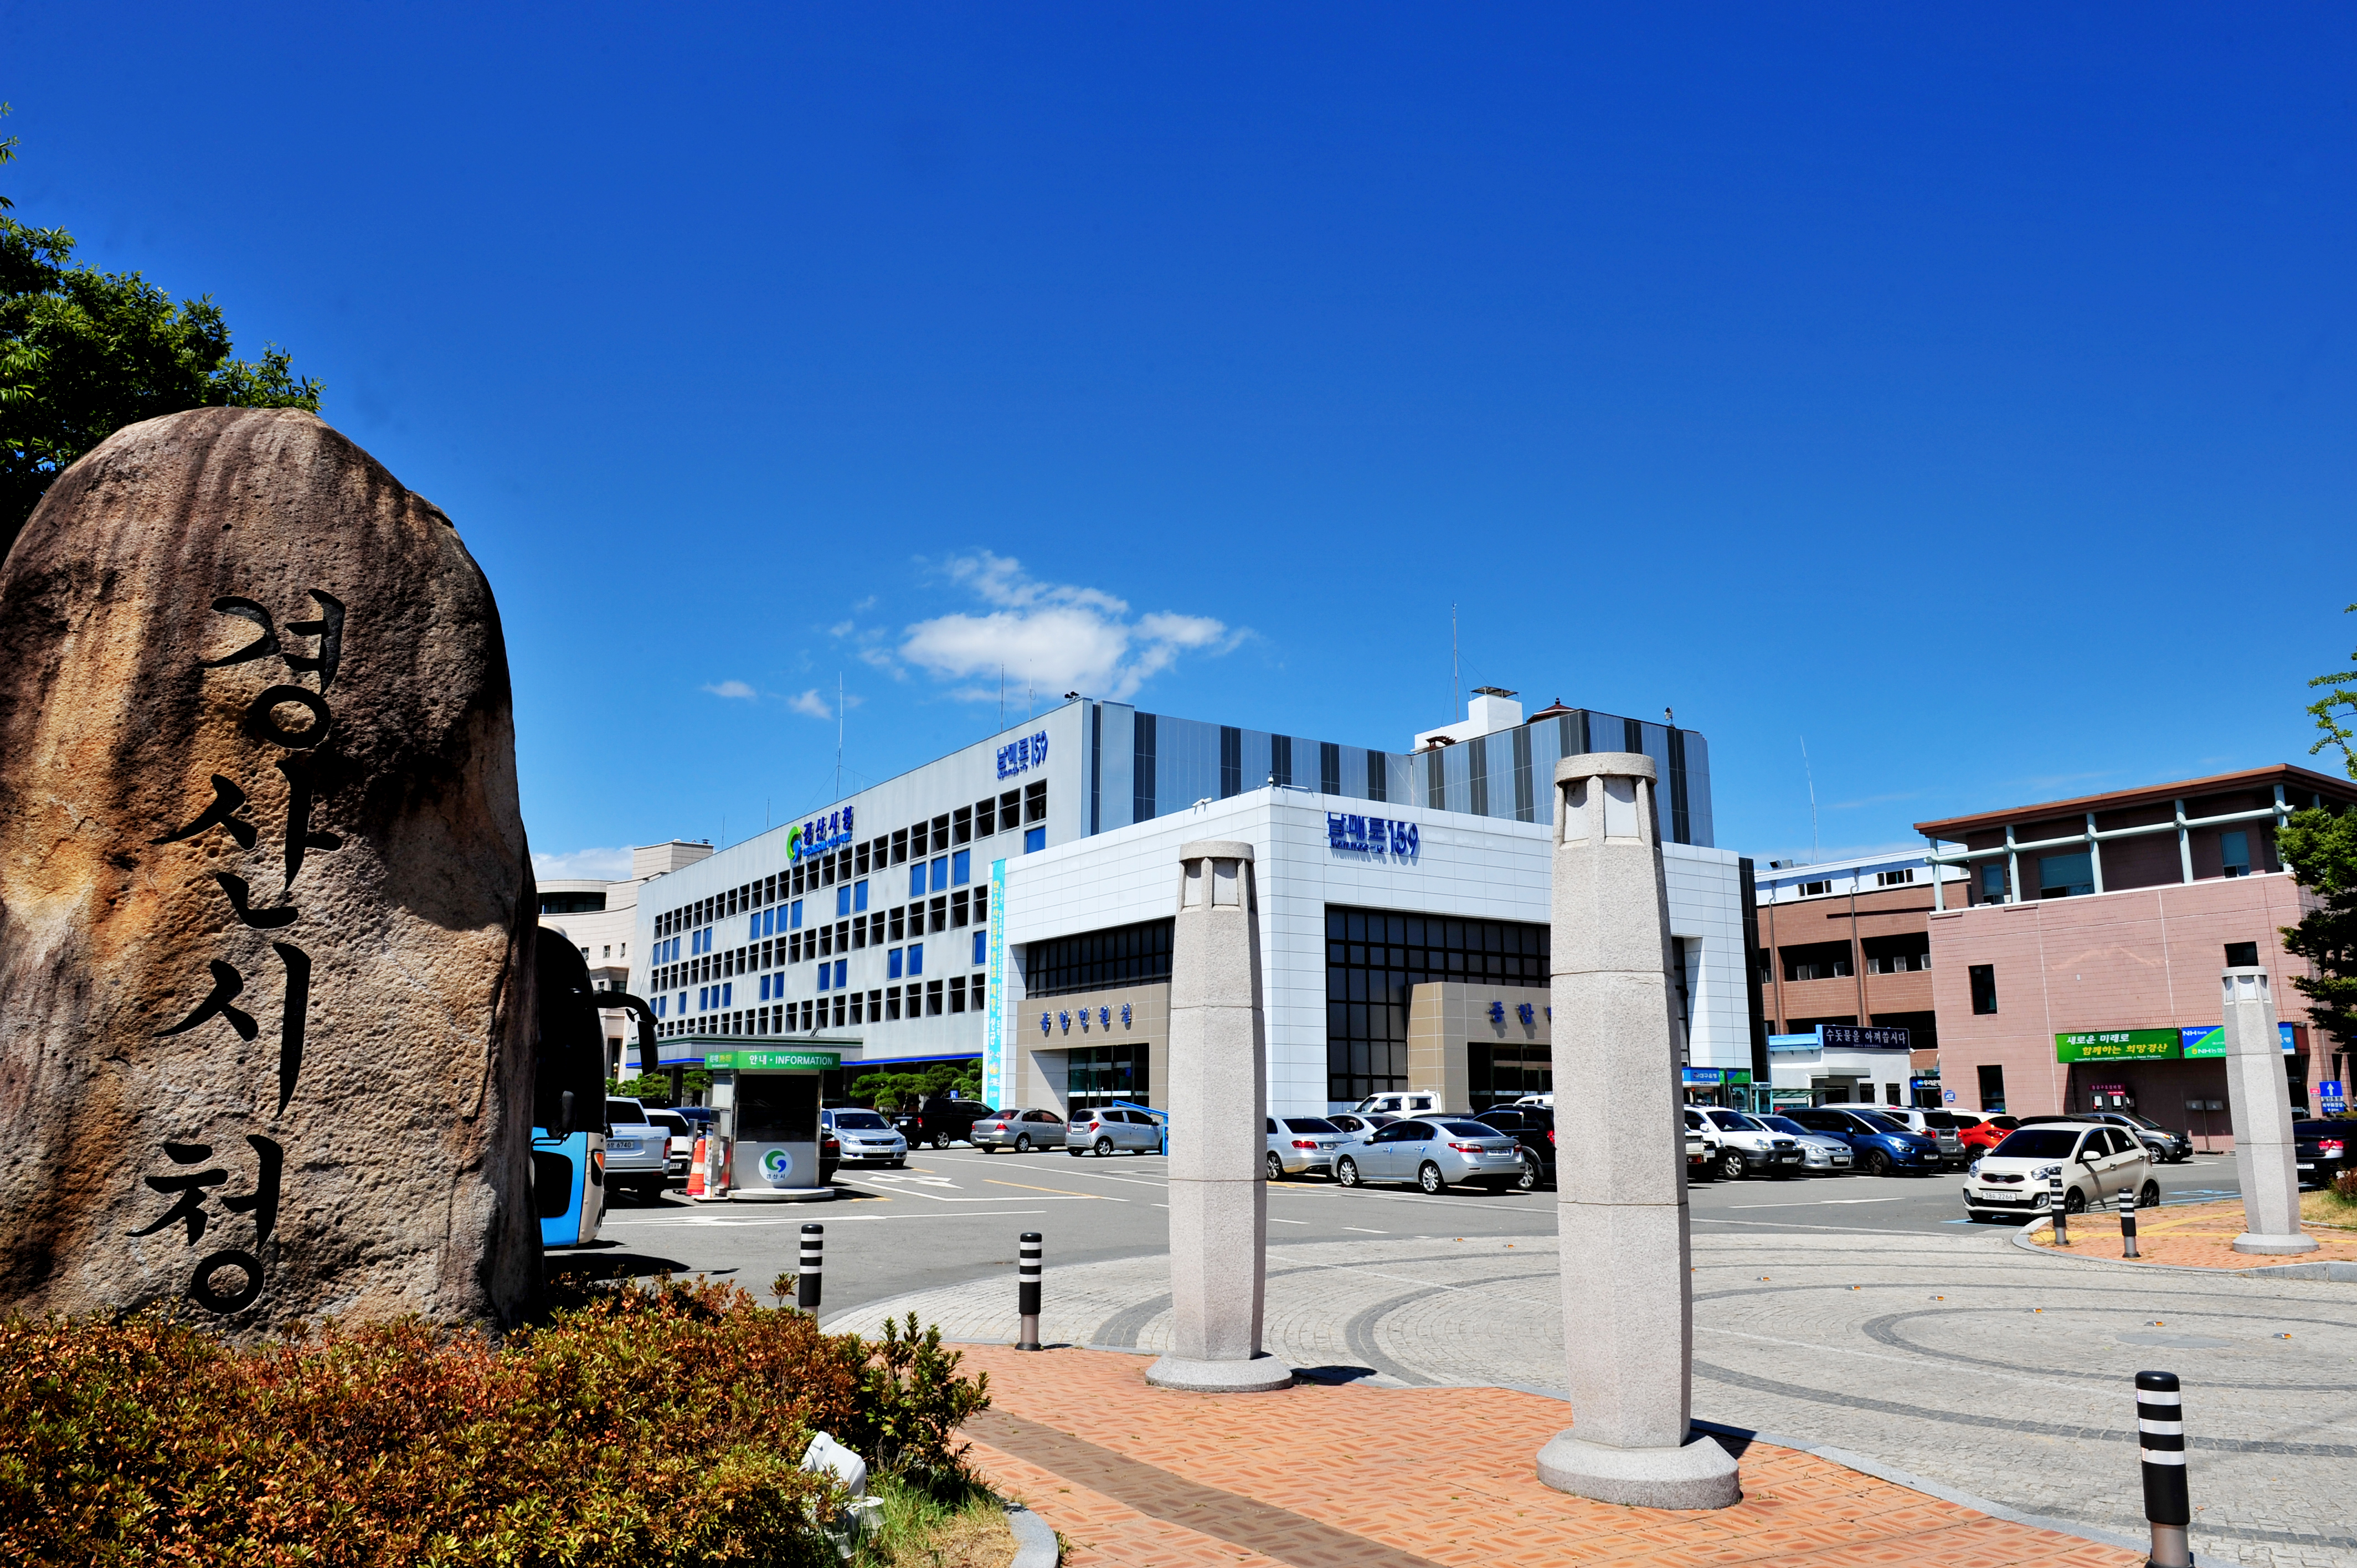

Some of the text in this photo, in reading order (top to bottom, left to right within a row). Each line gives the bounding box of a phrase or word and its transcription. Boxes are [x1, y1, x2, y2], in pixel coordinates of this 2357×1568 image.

[997, 730, 1048, 770] 남매로 159
[803, 806, 852, 845] 경산시청
[1327, 812, 1418, 855] 남매로 159
[126, 588, 346, 1314] 경산시청
[990, 1017, 996, 1045] 성공
[1040, 1003, 1133, 1031] 종합민원실
[1826, 1029, 1906, 1045] 수돗물을 아껴씁시다
[2066, 1034, 2129, 1045] 새로운 미래로
[2082, 1043, 2168, 1056] 함께하는 희망경산
[749, 1055, 833, 1065] 안내 INFORMATION
